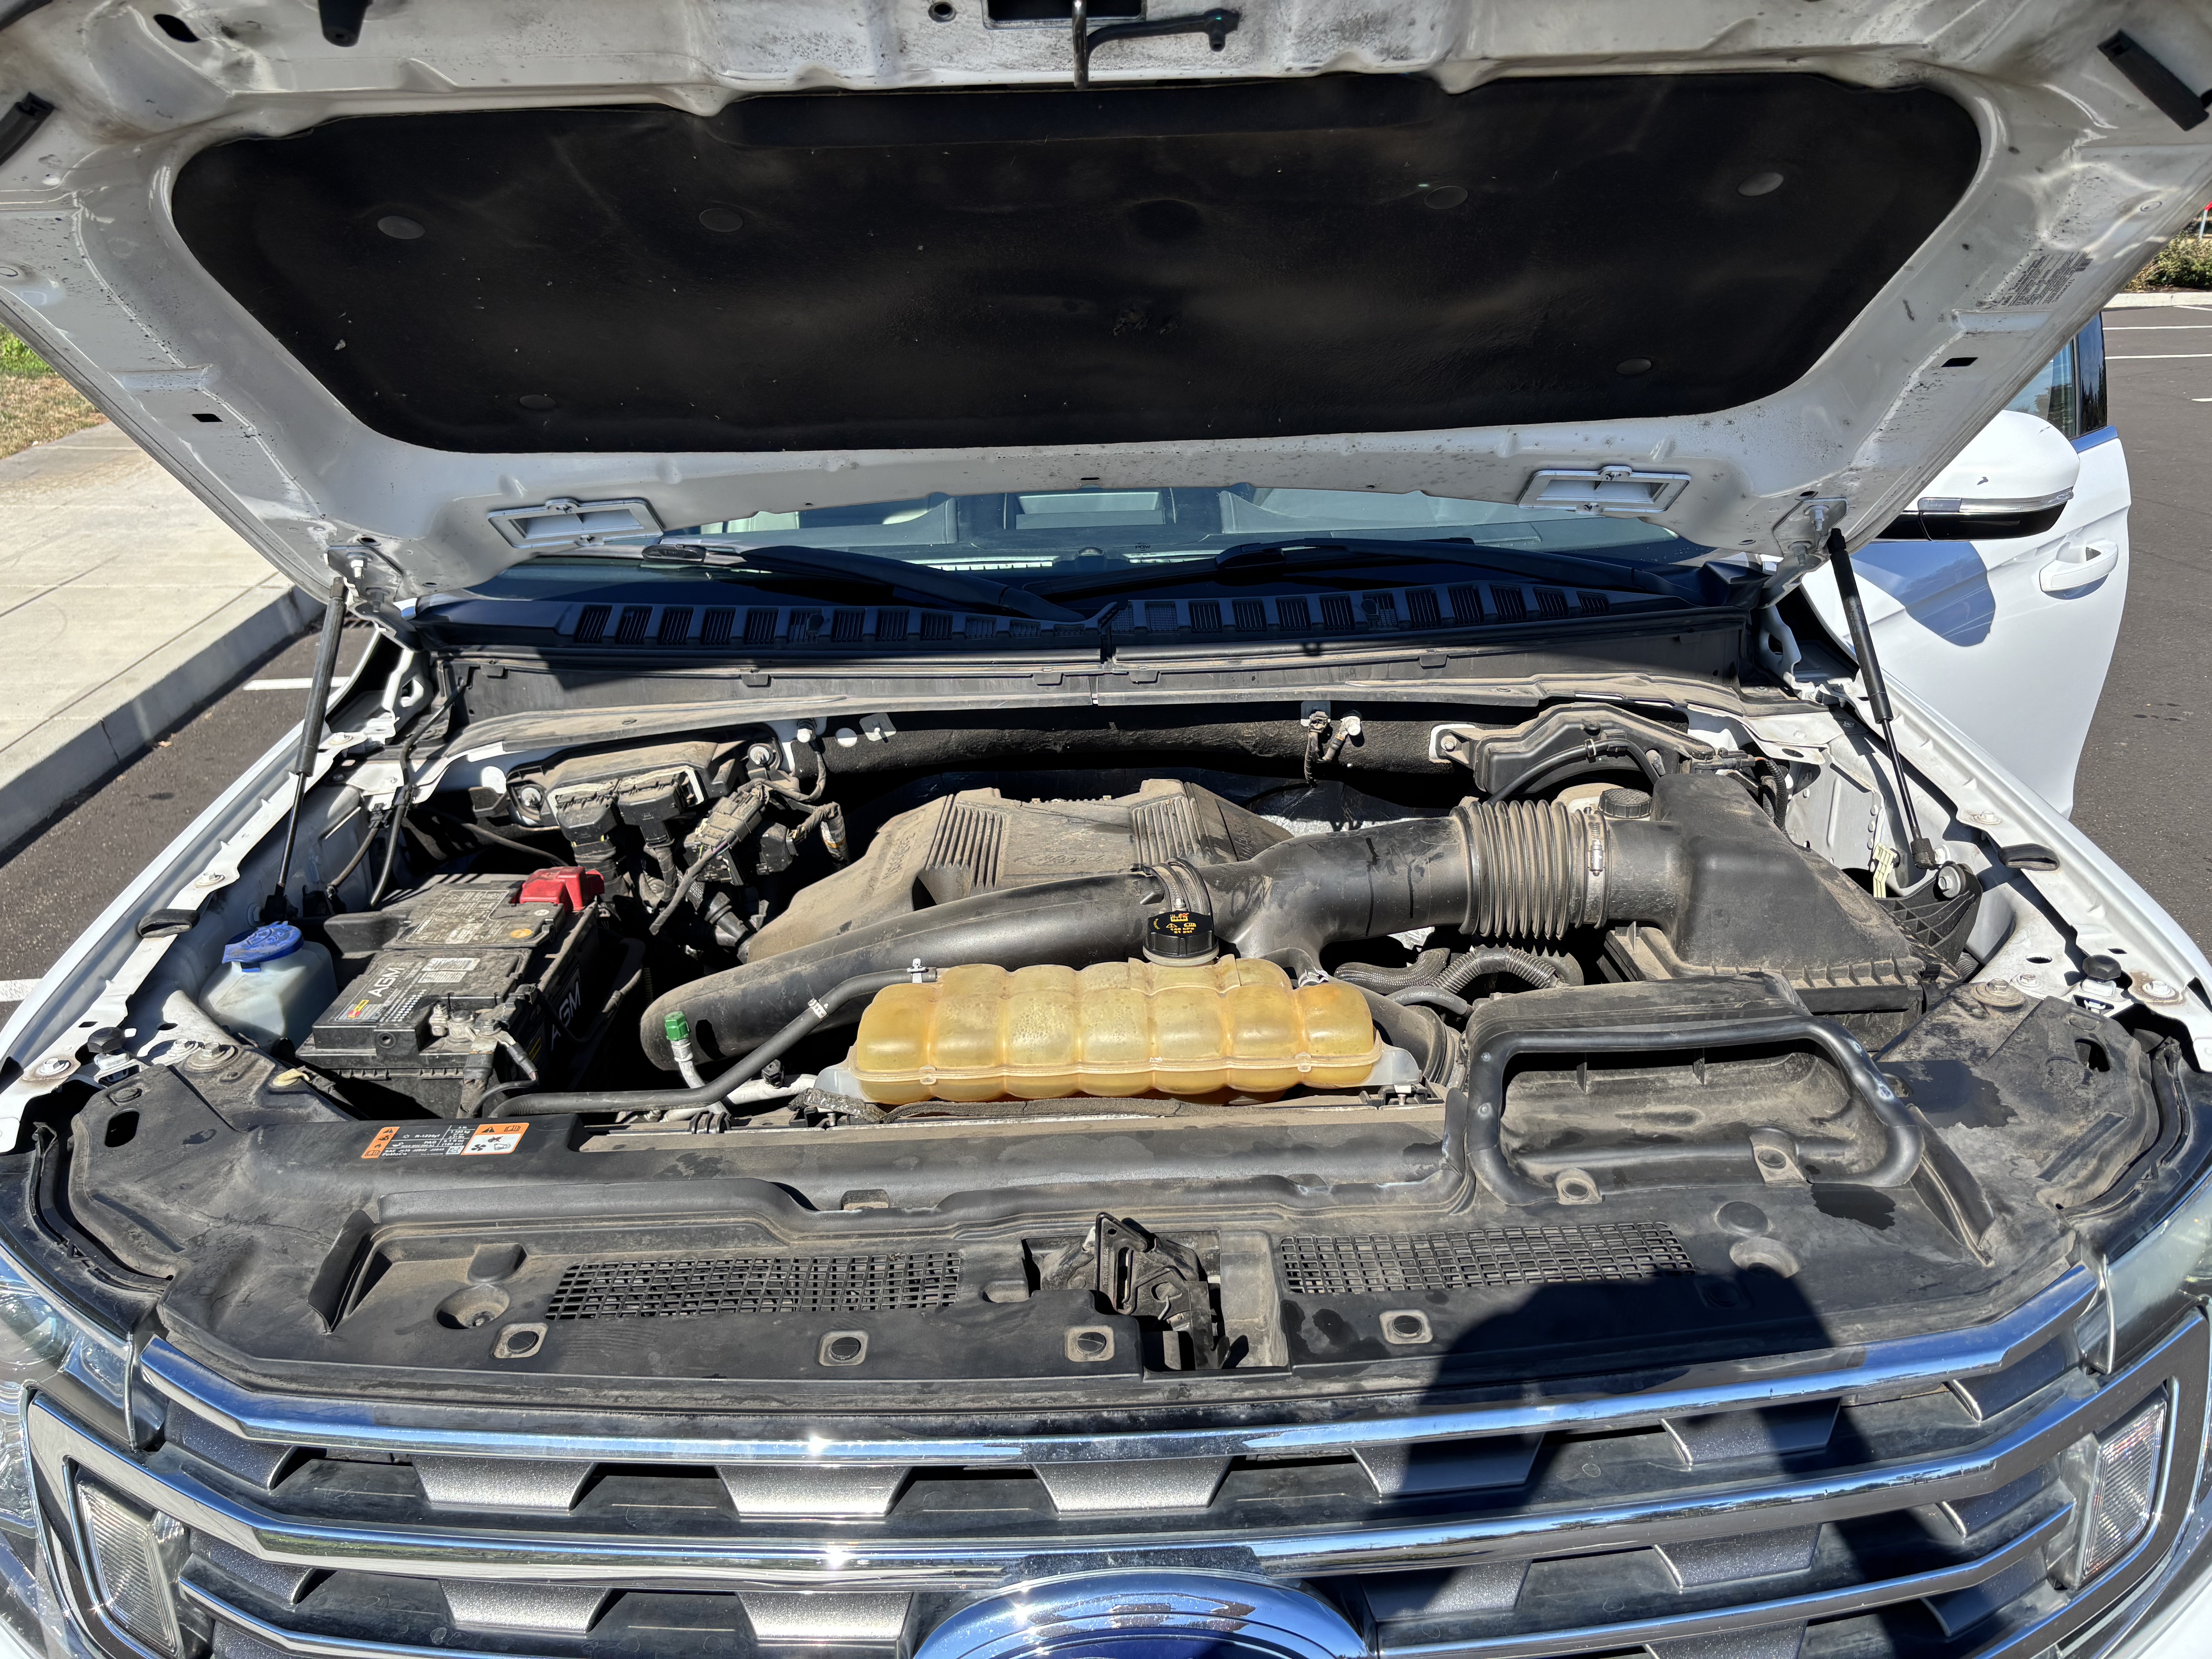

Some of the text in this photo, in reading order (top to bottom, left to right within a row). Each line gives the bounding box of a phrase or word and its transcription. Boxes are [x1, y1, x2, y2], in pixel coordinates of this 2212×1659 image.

[368, 967, 405, 998] AGM
[1439, 994, 1454, 1003] COOPER
[551, 981, 581, 1051] AGM
